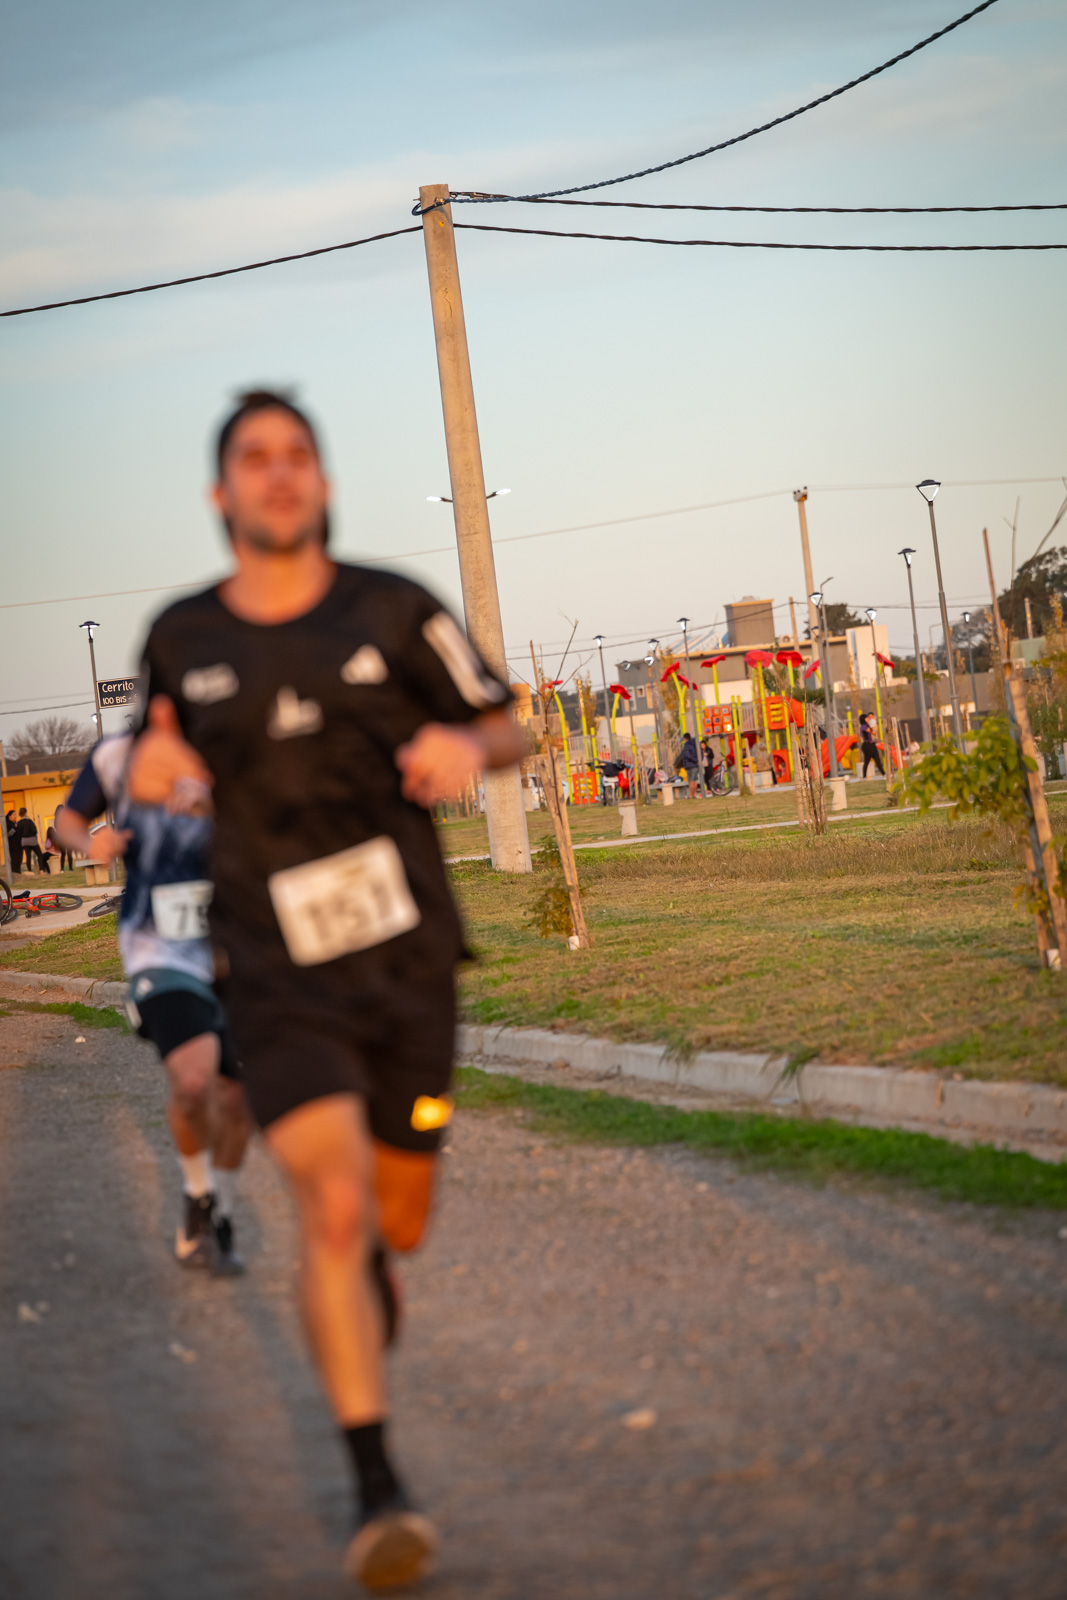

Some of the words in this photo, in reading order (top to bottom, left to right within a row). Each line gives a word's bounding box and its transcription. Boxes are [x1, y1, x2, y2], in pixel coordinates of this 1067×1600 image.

[102, 680, 134, 693] Cerrito
[102, 697, 114, 705] 100
[115, 695, 127, 704] BIS
